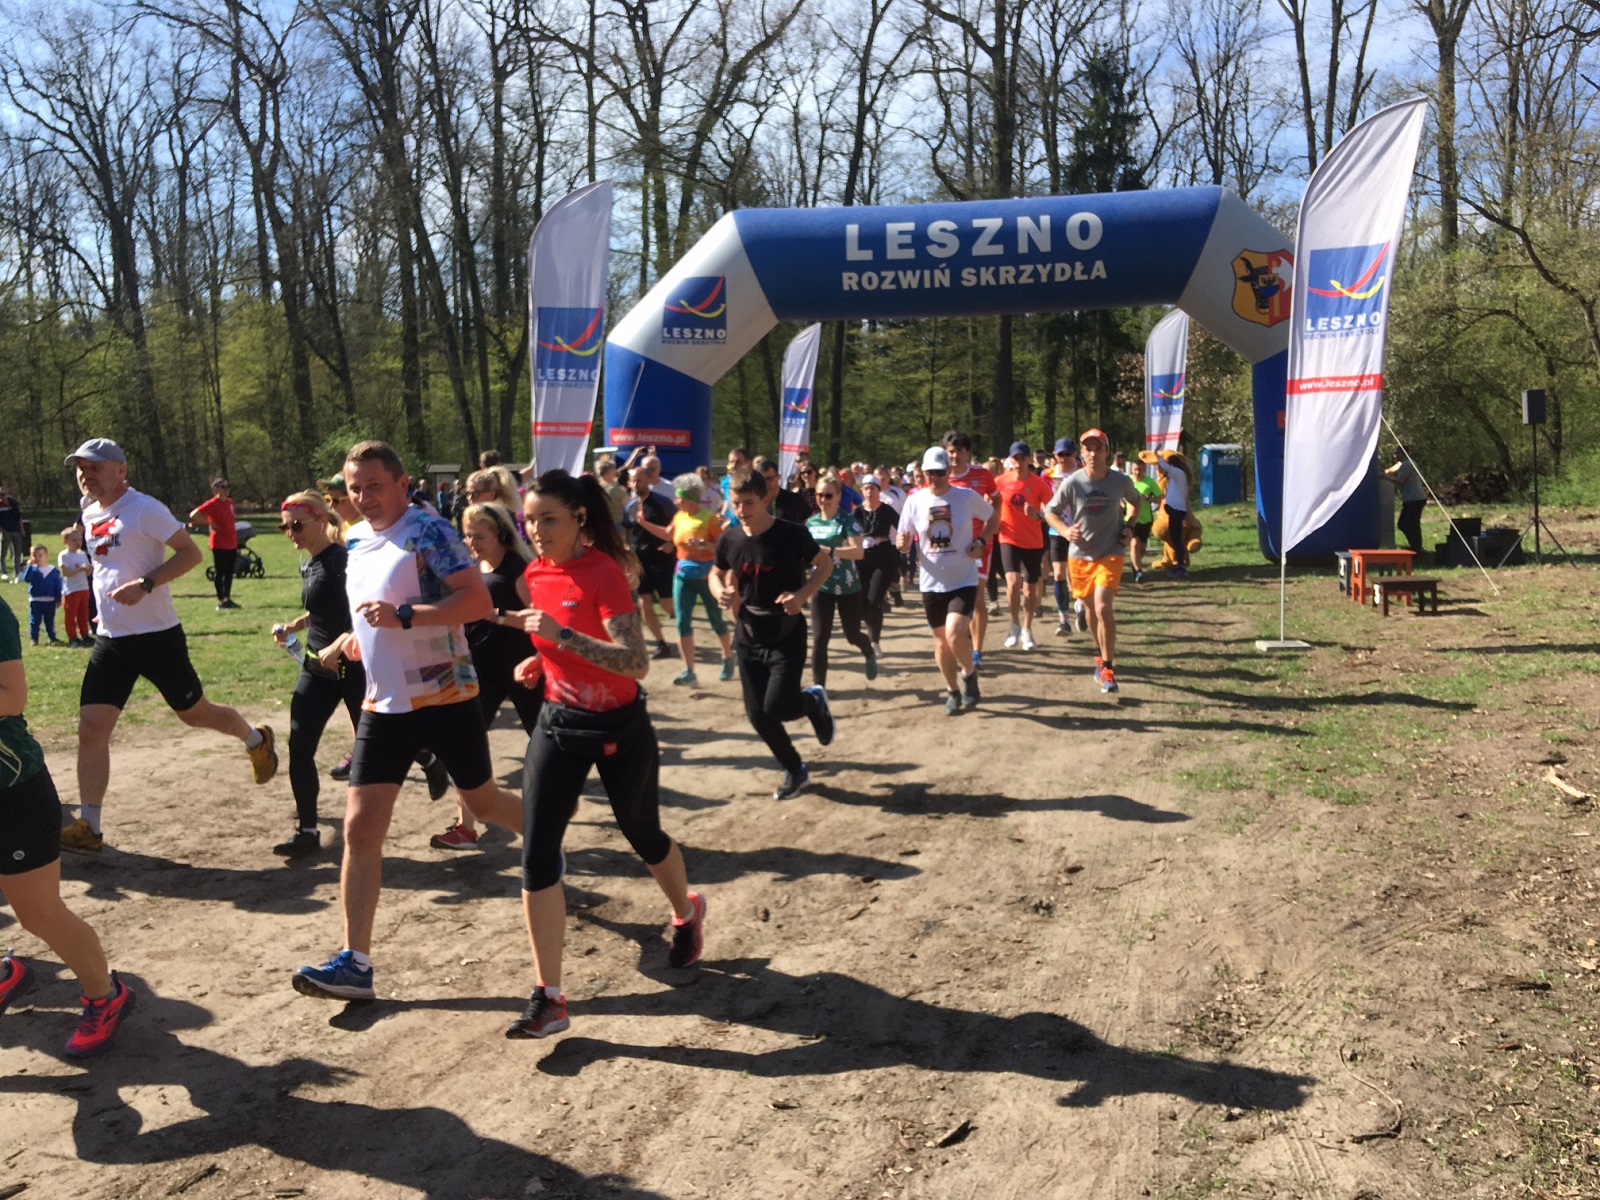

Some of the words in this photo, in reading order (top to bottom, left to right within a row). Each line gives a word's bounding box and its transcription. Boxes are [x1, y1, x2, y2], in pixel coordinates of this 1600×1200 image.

[845, 211, 1104, 262] LESZNO
[842, 263, 951, 291] ROZWIŃ
[961, 260, 1108, 287] SKRZYDŁA
[1306, 311, 1381, 332] LESZNO
[663, 327, 728, 339] LESZNO
[1299, 376, 1375, 391] www.leszno.pl
